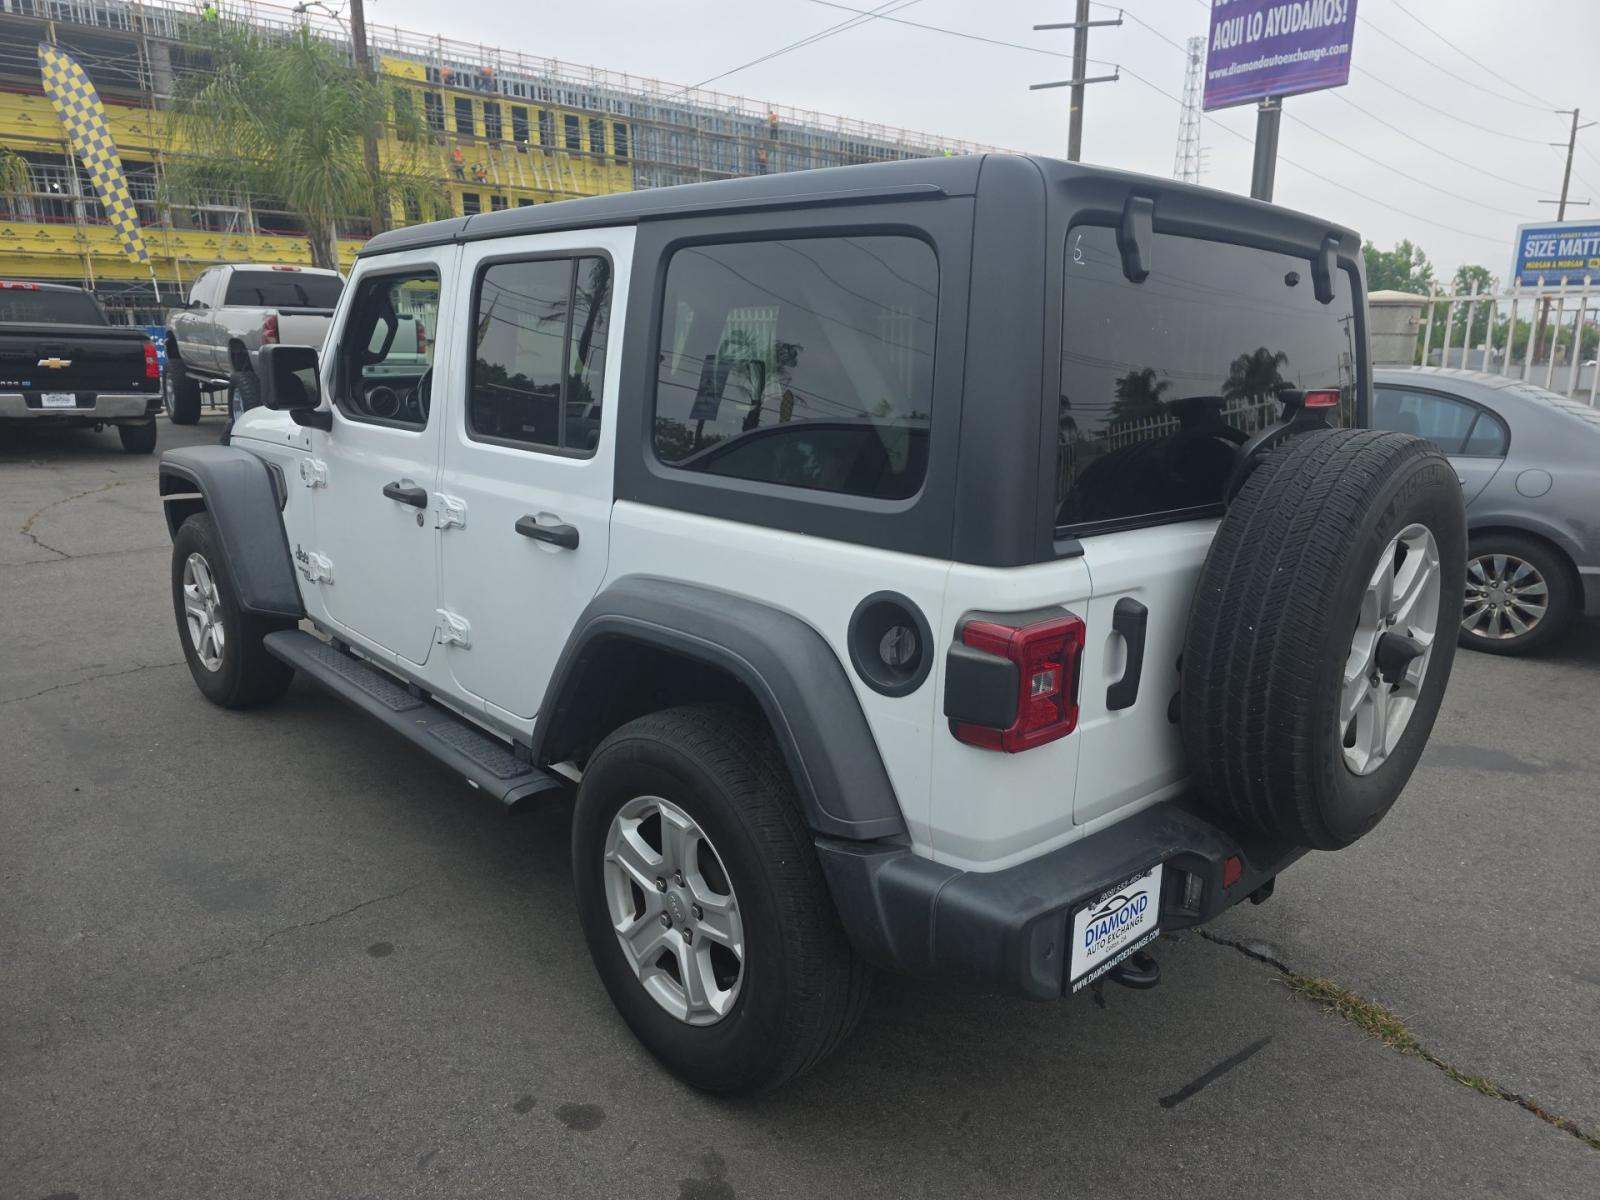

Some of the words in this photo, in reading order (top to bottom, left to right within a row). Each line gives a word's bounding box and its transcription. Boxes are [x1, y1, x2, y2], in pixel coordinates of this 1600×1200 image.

[1213, 16, 1244, 50] AQUI
[1246, 12, 1263, 43] LO
[1264, 0, 1348, 38] AYUDAMOS!
[1208, 43, 1349, 80] www.diamondautoexchange.com
[1524, 240, 1557, 258] SIZE
[1558, 238, 1600, 256] MATT
[1085, 895, 1148, 948] DIAMOND
[1086, 938, 1106, 958] AUTO
[1107, 913, 1144, 945] EXCHANGE
